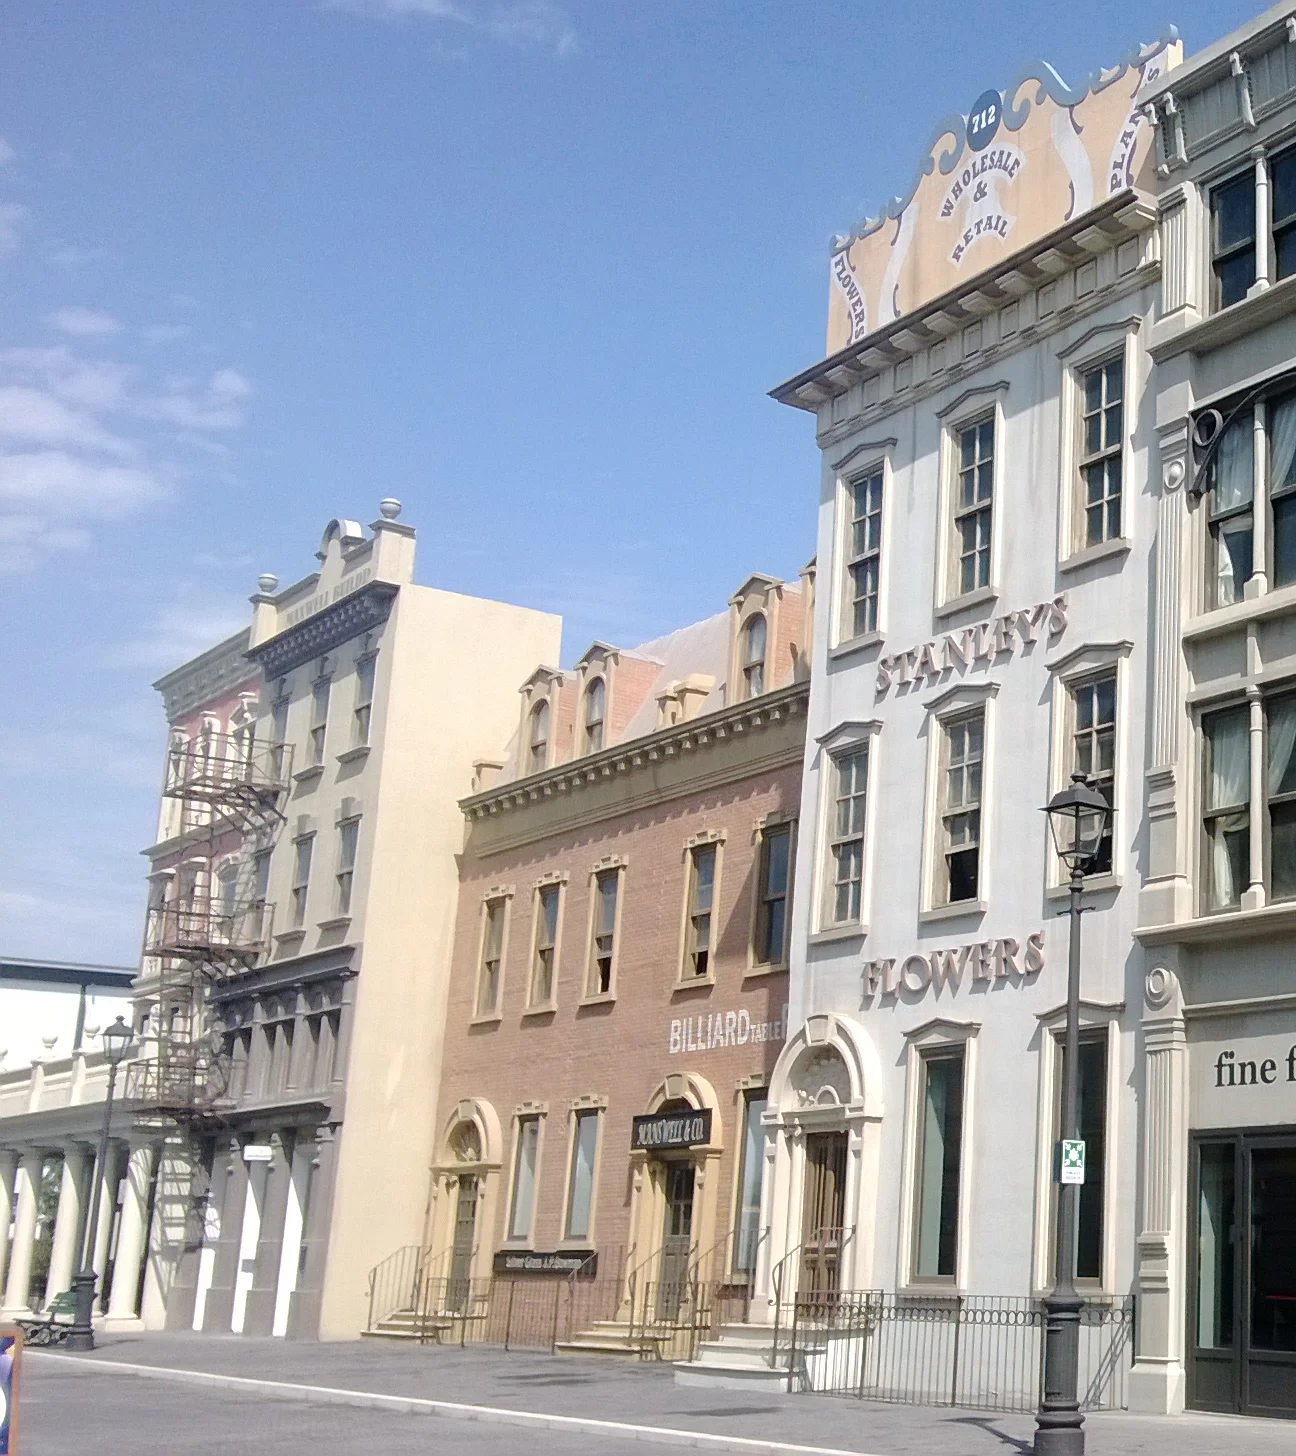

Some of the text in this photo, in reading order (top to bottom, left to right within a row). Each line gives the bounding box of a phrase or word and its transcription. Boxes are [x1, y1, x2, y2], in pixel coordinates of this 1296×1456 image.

[972, 105, 996, 134] 712
[940, 150, 1020, 218] WHOLESALE
[973, 179, 988, 203] &
[951, 214, 1009, 263] RETAIL
[834, 255, 865, 340] FLOWERS
[876, 592, 1069, 692] STANLEY'S
[861, 930, 1045, 999] FLOWERS
[669, 1009, 750, 1054] BILLIARD
[1214, 1050, 1277, 1088] fine
